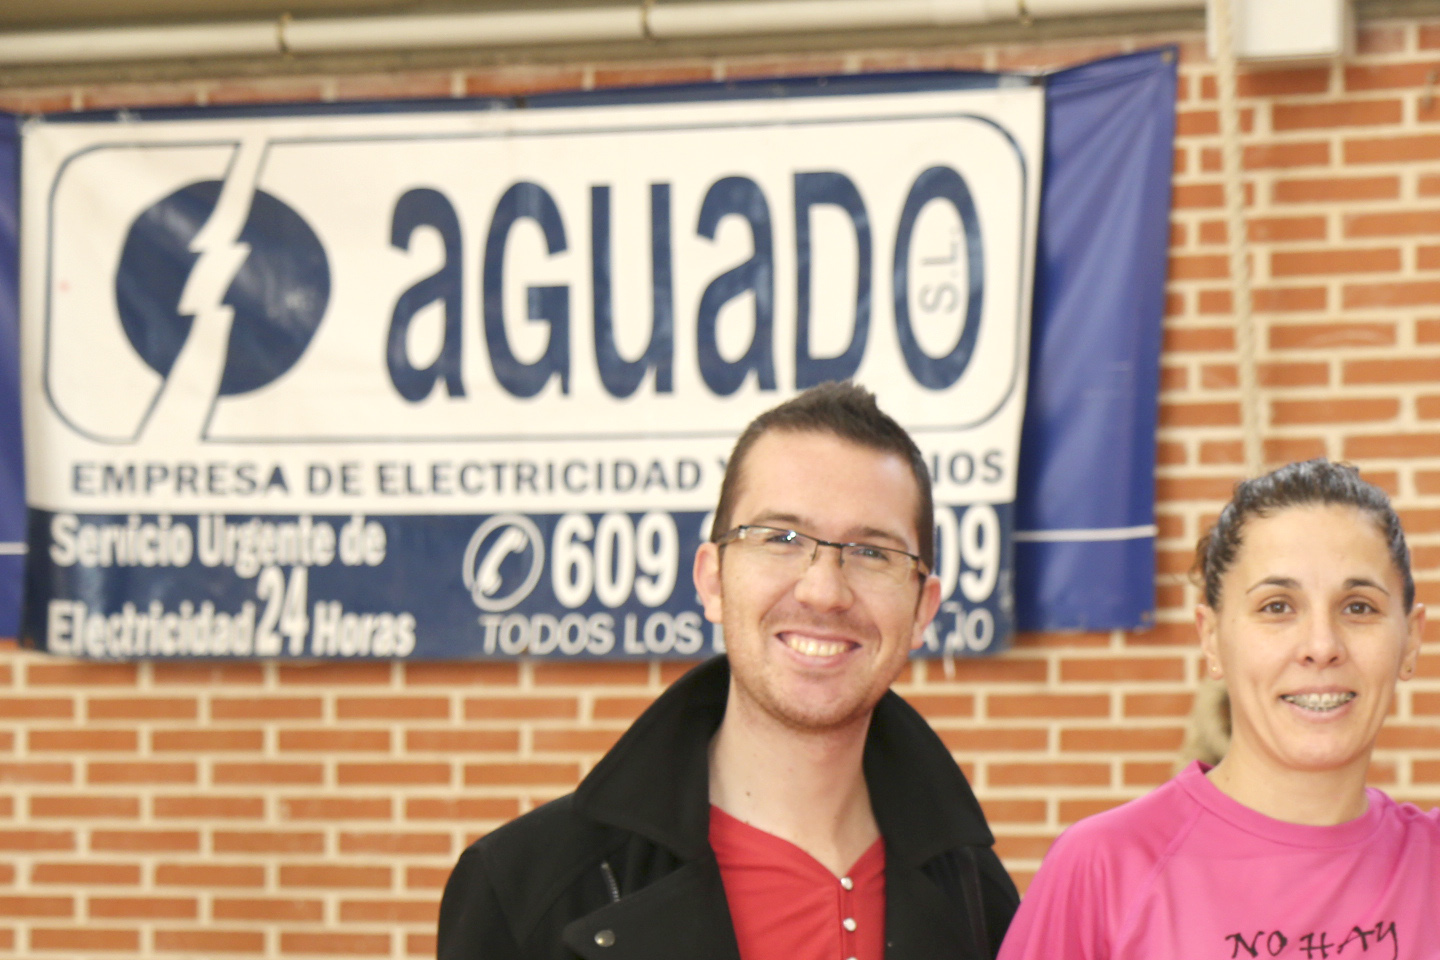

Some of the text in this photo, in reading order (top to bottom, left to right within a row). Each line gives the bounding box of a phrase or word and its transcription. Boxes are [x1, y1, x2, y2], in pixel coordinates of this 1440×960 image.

[71, 461, 290, 496] EMPRESA
[307, 462, 364, 495] DE
[376, 458, 702, 496] ELECTRICIDAD
[929, 450, 1004, 485] IOS
[49, 514, 388, 578] Servicio Urgente de
[551, 511, 680, 609] 609
[47, 566, 417, 659] Electricidad 24 Horas
[478, 612, 616, 655] TODOS
[622, 611, 704, 655] LOS
[1225, 930, 1289, 960] NO
